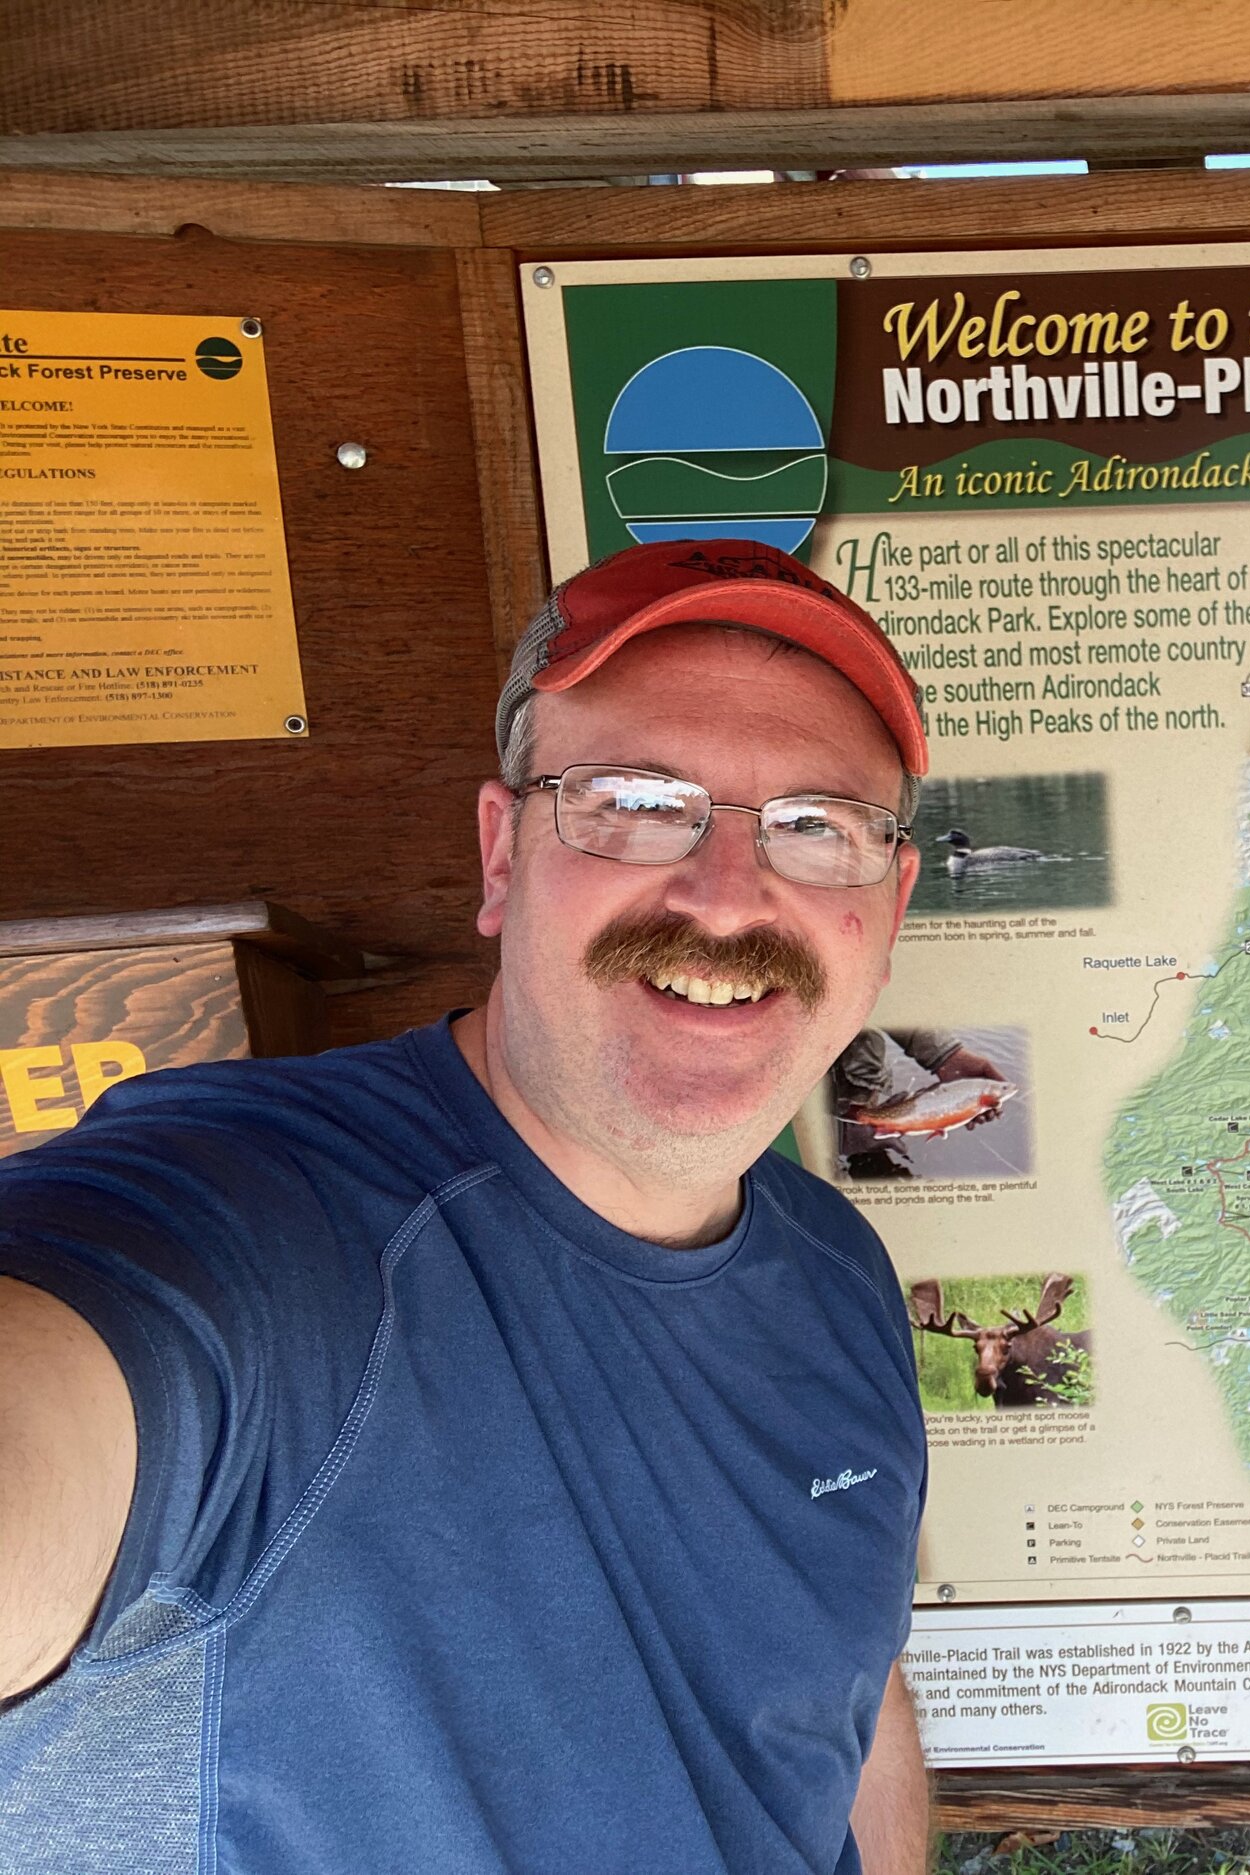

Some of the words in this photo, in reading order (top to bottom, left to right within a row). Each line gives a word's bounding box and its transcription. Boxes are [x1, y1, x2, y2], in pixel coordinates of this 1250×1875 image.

[883, 291, 1149, 362] Welcome
[1169, 300, 1228, 352] to
[28, 364, 93, 379] Forest
[101, 366, 187, 381] Preserve
[888, 465, 944, 502] An
[955, 461, 1053, 496] iconic
[835, 531, 912, 602] Hike
[919, 540, 961, 571] part
[968, 545, 989, 564] or
[996, 536, 1018, 564] all
[1026, 535, 1048, 563] of
[1052, 534, 1090, 562] this
[1097, 531, 1221, 571] spectacular
[884, 571, 972, 601] 133-mile
[979, 571, 1033, 598] route
[1039, 569, 1120, 606] through
[1127, 567, 1160, 594] the
[1166, 567, 1220, 593] heart
[1227, 564, 1248, 590] of
[877, 608, 980, 637] dirondack
[987, 605, 1041, 634] Park.
[1049, 603, 1127, 637] Explore
[1134, 606, 1191, 628] some
[1198, 601, 1219, 626] of
[903, 641, 977, 670] wildest
[984, 639, 1023, 668] and
[1029, 642, 1079, 666] most
[1087, 639, 1161, 664] remote
[1167, 637, 1246, 666] country
[71, 669, 101, 679] AND
[107, 668, 140, 678] LAW
[145, 665, 258, 677] ENFORCEMENT
[944, 675, 1036, 703] southern
[1042, 671, 1161, 700] Adirondack
[937, 711, 969, 737] the
[976, 709, 1023, 742] High
[1030, 707, 1092, 734] Peaks
[1100, 706, 1121, 731] of
[1127, 705, 1159, 730] the
[1165, 704, 1225, 729] north.
[898, 933, 941, 942] common
[945, 932, 965, 941] loon
[968, 932, 976, 940] in
[980, 931, 1013, 942] spring,
[1016, 930, 1054, 939] summer
[1058, 929, 1076, 938] and
[1080, 928, 1096, 937] fall.
[1083, 957, 1142, 970] Raquette
[1146, 955, 1177, 967] Lake
[1102, 1012, 1129, 1023] Inlet
[1048, 1522, 1083, 1530] Lean-To
[1155, 1519, 1211, 1528] Conservation
[1049, 1539, 1081, 1548] Parking
[993, 1647, 1020, 1661] Trail
[1026, 1649, 1053, 1659] was
[1058, 1643, 1135, 1660] established
[1140, 1642, 1151, 1656] in
[1158, 1642, 1191, 1656] 1922
[1197, 1639, 1212, 1658] by
[1218, 1639, 1239, 1654] the
[913, 1667, 986, 1682] maintained
[993, 1667, 1007, 1681] by
[1013, 1666, 1034, 1678] the
[1040, 1665, 1066, 1678] NYS
[1072, 1662, 1150, 1680] Department
[1155, 1660, 1168, 1675] of
[926, 1687, 950, 1699] and
[957, 1685, 1041, 1699] commitment
[1047, 1683, 1060, 1696] of
[1066, 1682, 1087, 1696] the
[1092, 1680, 1168, 1695] Adirondack
[1174, 1679, 1236, 1693] Mountain
[932, 1705, 955, 1718] and
[961, 1706, 996, 1719] many
[1001, 1703, 1047, 1716] others.
[1188, 1704, 1228, 1714] Leave
[1189, 1716, 1209, 1727] No
[1189, 1728, 1227, 1738] Trace
